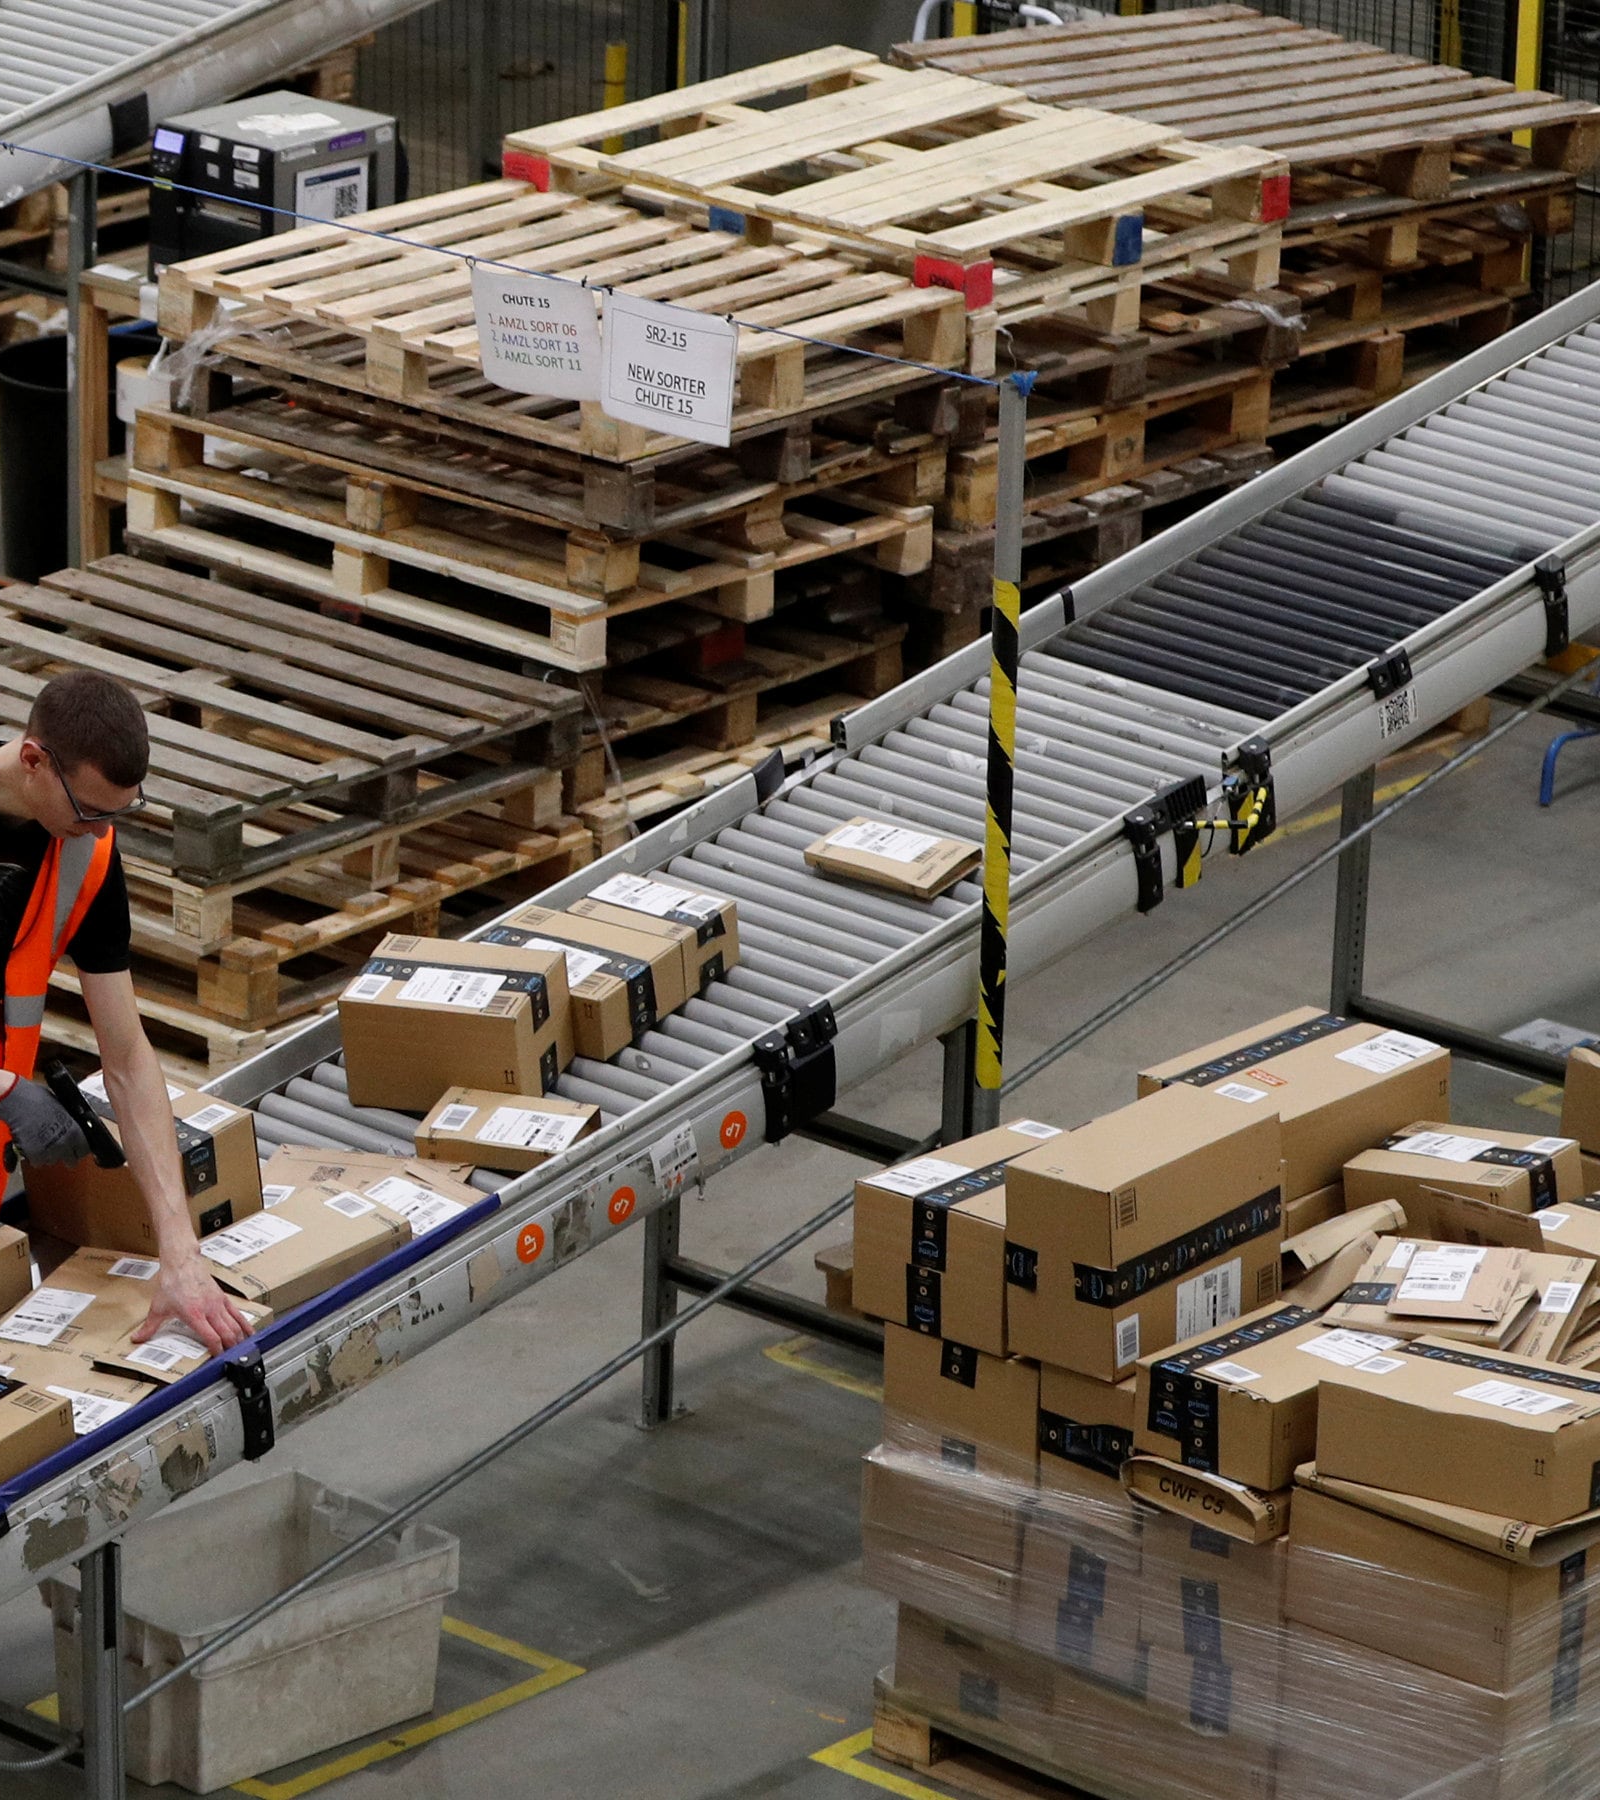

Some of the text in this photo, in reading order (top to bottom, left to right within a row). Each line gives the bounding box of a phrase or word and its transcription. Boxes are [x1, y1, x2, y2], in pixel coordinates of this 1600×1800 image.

[502, 293, 551, 309] CHUTE 15
[499, 315, 528, 331] AMZL
[530, 320, 559, 334] SORT
[562, 323, 578, 336] 06
[646, 324, 687, 348] SR2-15
[502, 333, 531, 348] AMZL
[533, 338, 562, 352] SORT
[566, 341, 580, 354] 13
[504, 350, 534, 366] AMZL
[536, 355, 565, 369] SORT
[569, 359, 582, 371] 11
[627, 362, 706, 395] NEW SORTER
[635, 387, 694, 415] CHUTE 15
[725, 1122, 741, 1139] LP
[613, 1198, 629, 1215] LP
[524, 1233, 538, 1256] LP
[1159, 1477, 1225, 1515] CWF C5
